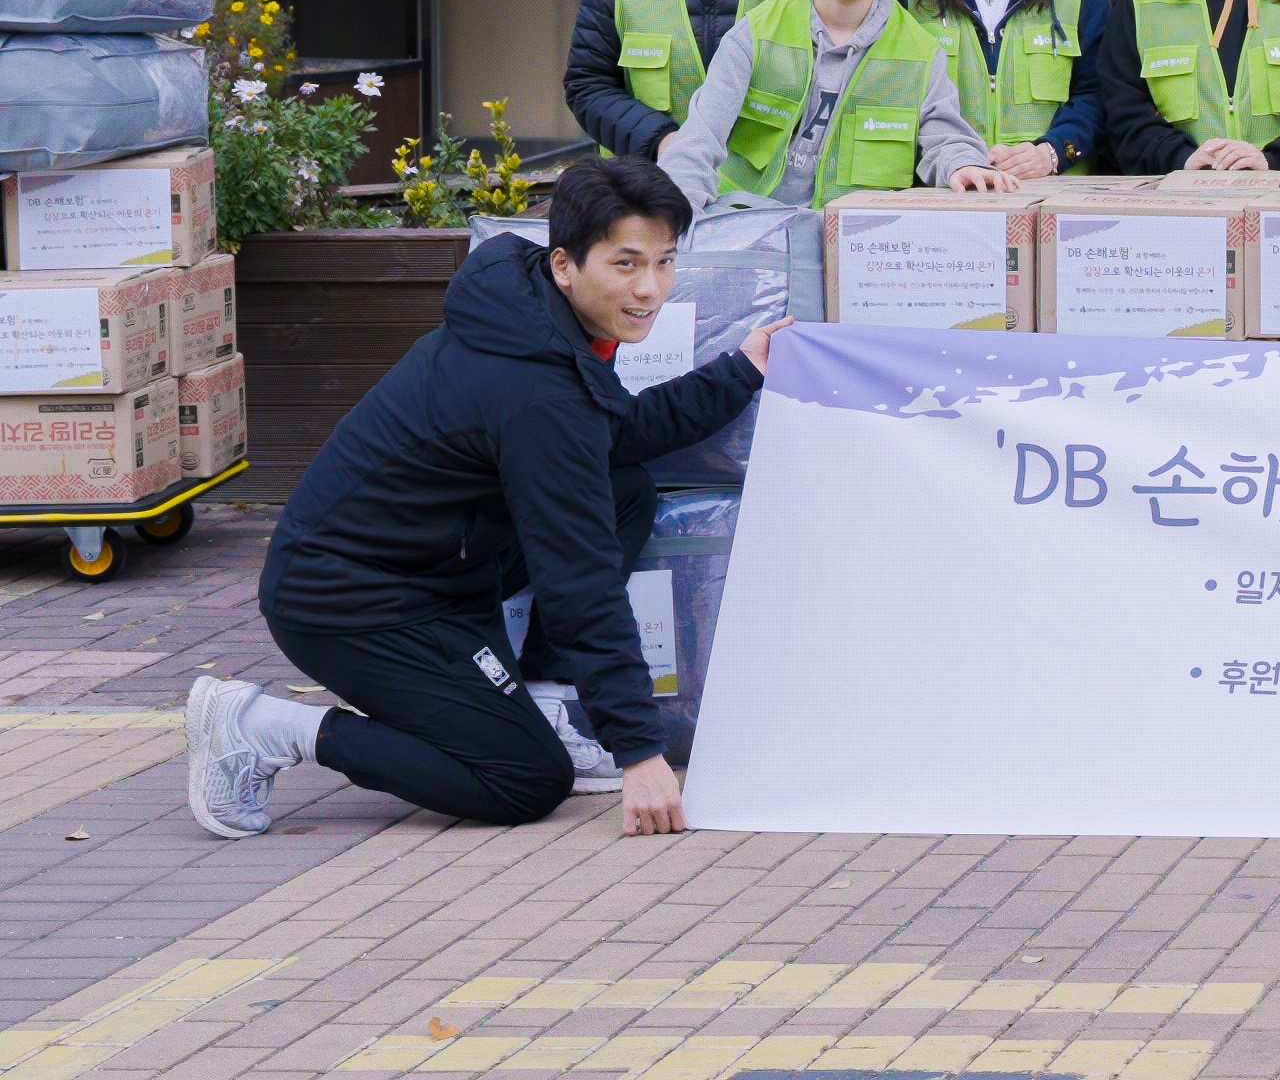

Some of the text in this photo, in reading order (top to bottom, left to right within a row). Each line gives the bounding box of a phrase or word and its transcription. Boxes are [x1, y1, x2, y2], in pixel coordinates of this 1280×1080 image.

[800, 89, 839, 142] A
[866, 262, 995, 272] 김장으로 확산되는 이웃의 온기
[1084, 267, 1215, 278] 김장으로 확산되는 이웃의 온기
[633, 352, 684, 365] 이웃의 온기
[1, 420, 116, 443] 우리땅 김치
[644, 622, 663, 633] 온기
